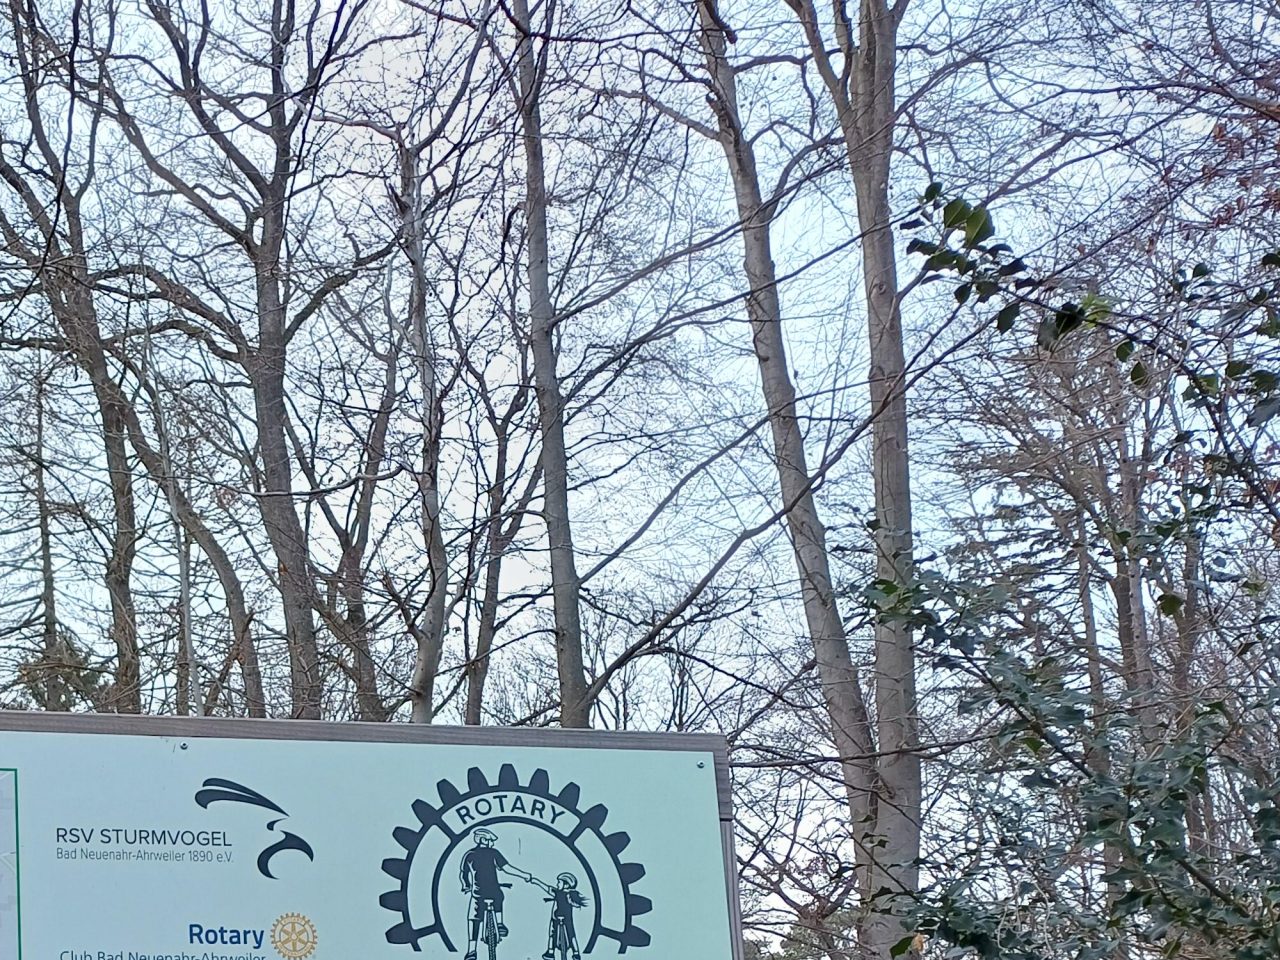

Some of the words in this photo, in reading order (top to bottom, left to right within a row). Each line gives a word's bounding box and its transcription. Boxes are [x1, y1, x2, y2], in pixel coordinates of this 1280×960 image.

[455, 794, 566, 826] ROTARY
[56, 827, 94, 844] RSV
[100, 828, 232, 847] STURMVOGEL
[56, 847, 77, 860] Bad
[80, 848, 185, 862] Neuenahr-Ahrweiler
[188, 850, 213, 862] 1890
[216, 851, 234, 863] e.V.
[189, 923, 265, 949] Rotary
